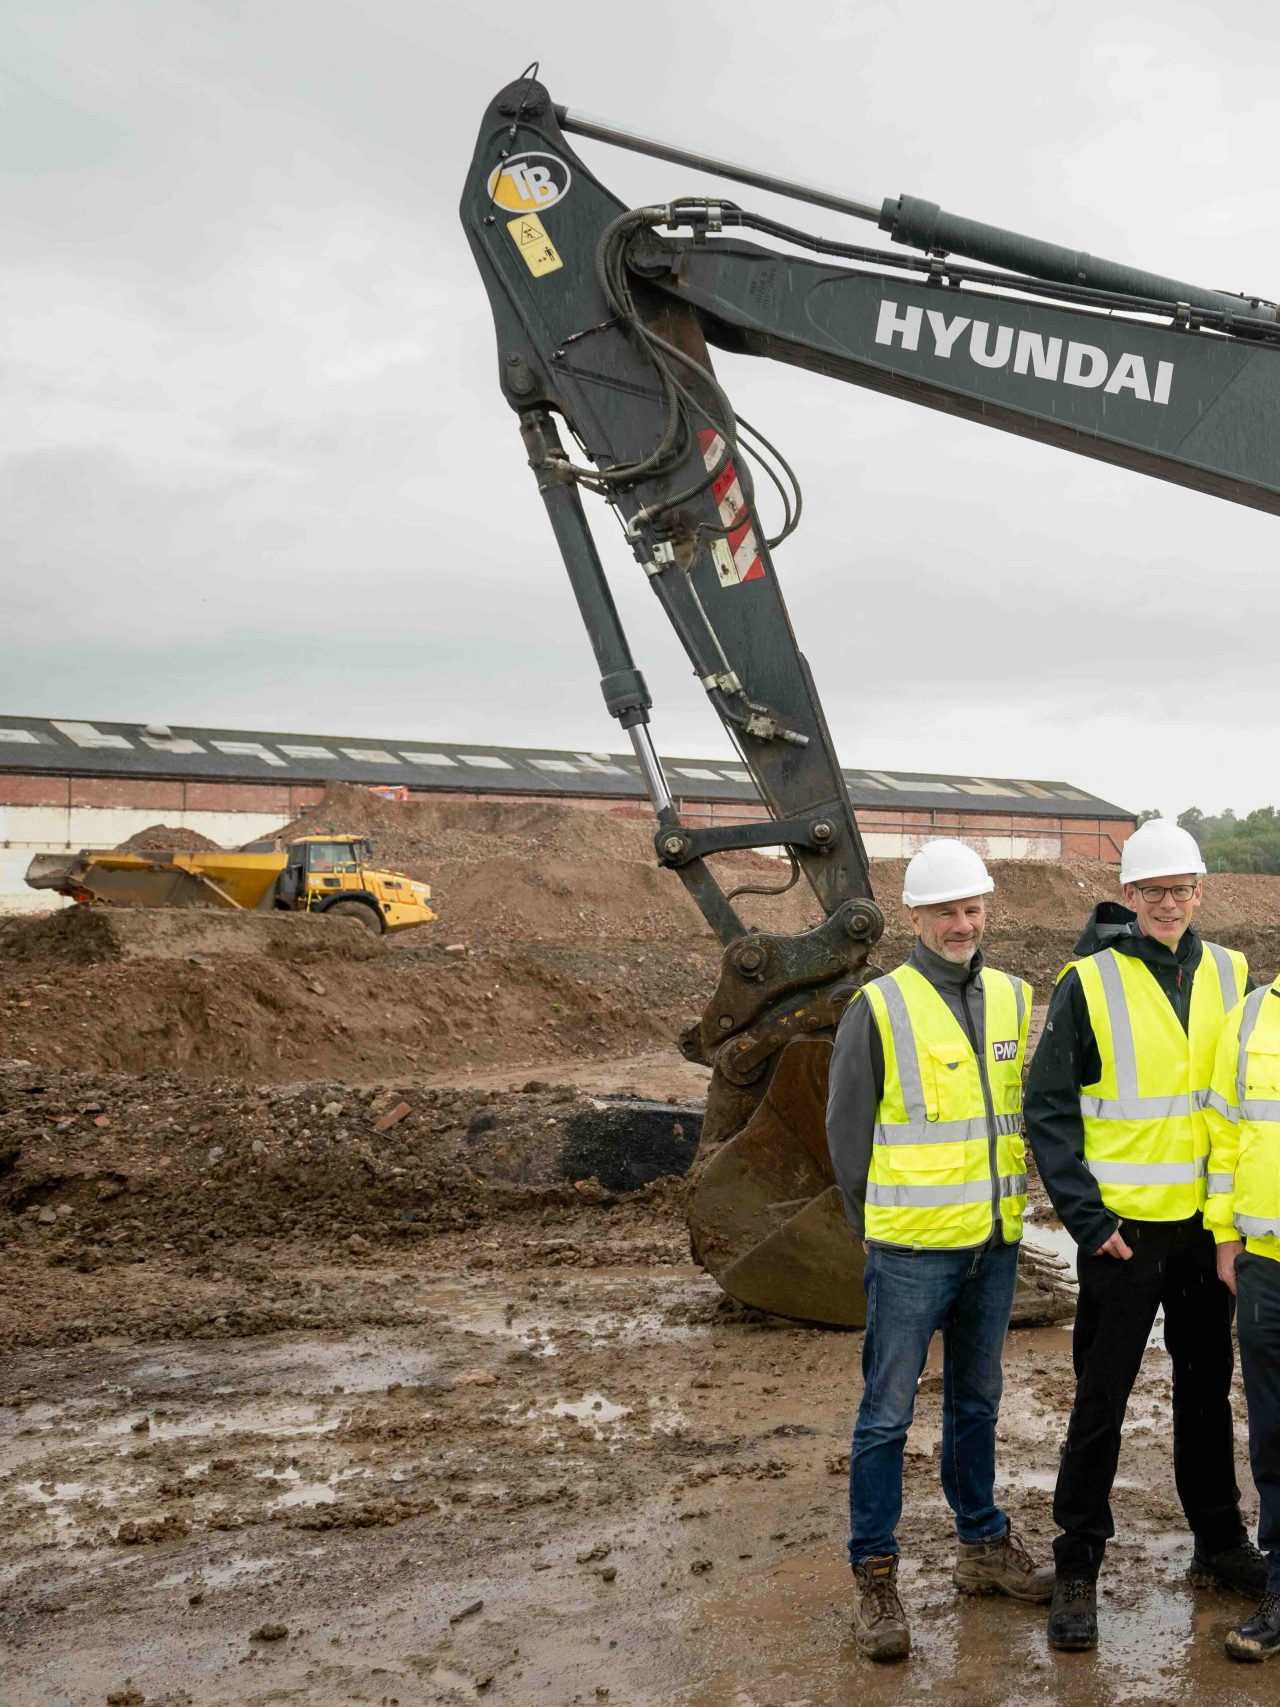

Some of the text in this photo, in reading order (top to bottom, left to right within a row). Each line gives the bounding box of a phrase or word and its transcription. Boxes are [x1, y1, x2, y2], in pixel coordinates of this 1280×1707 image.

[501, 162, 558, 204] TB
[875, 299, 1174, 405] HYUNDAI
[994, 1042, 1016, 1060] PMP
